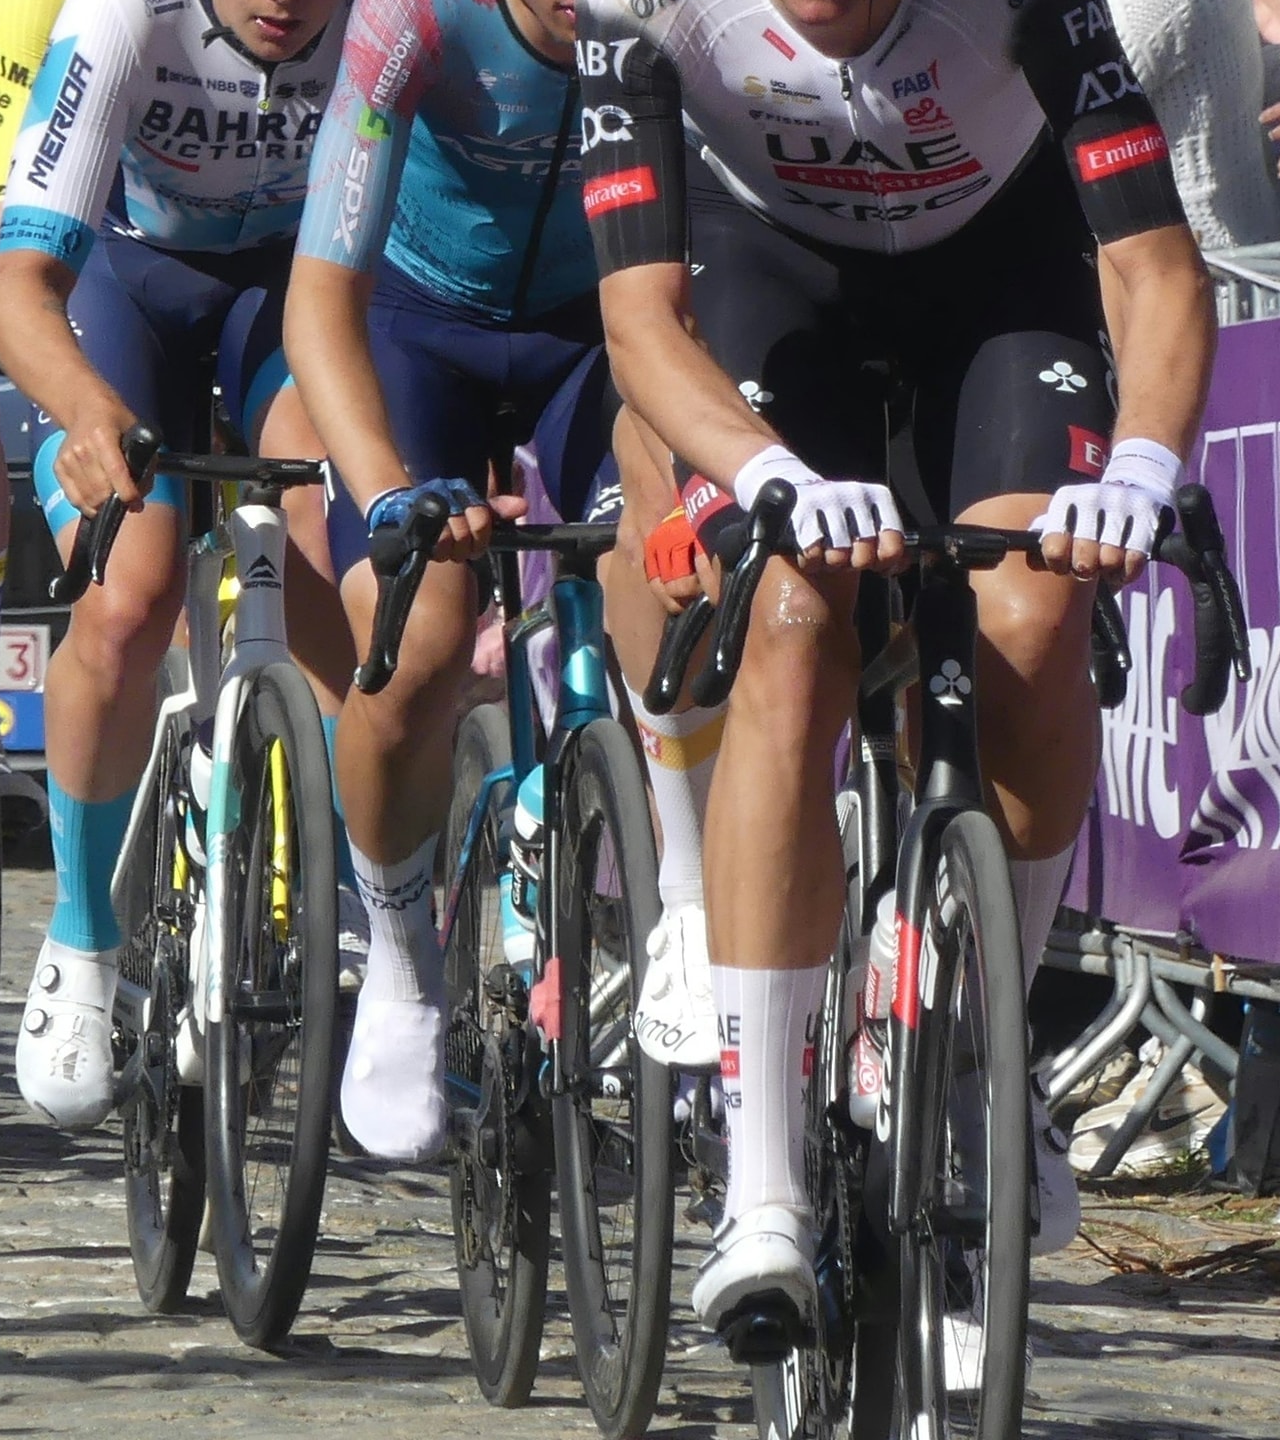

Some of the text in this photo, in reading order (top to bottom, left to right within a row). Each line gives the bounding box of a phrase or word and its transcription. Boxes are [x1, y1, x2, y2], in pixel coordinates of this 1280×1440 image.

[370, 28, 417, 105] FREEDOM
[205, 78, 238, 94] NBB
[891, 71, 932, 100] FAB
[27, 51, 94, 192] MERIDA
[765, 132, 971, 171] UAE
[583, 177, 643, 211] mirates
[5, 642, 28, 682] 3
[718, 1014, 742, 1046] AE
[724, 1090, 743, 1109] RG
